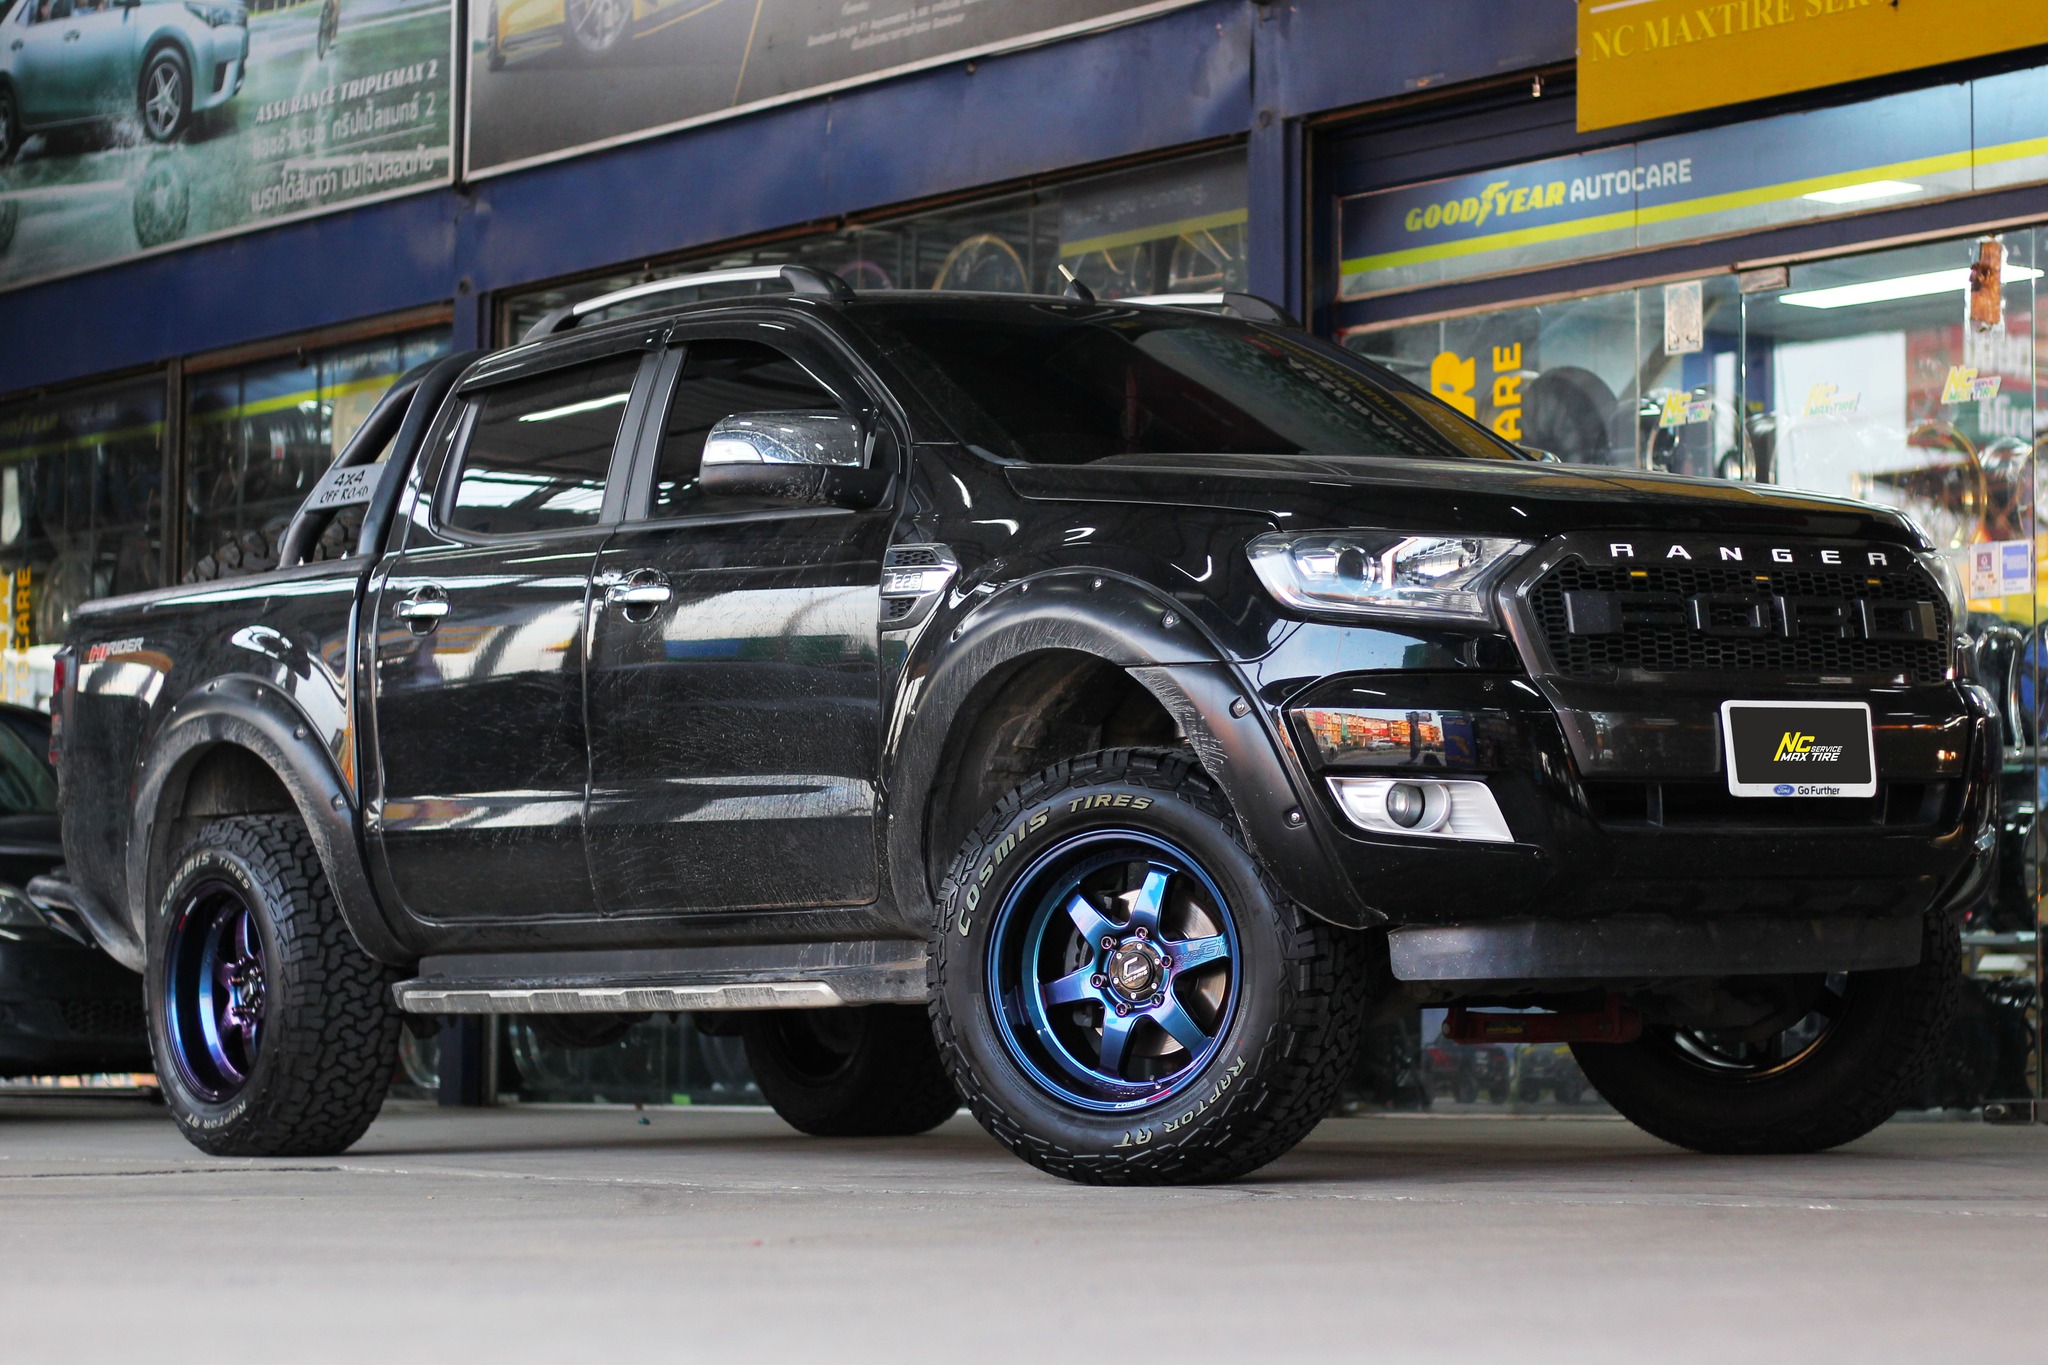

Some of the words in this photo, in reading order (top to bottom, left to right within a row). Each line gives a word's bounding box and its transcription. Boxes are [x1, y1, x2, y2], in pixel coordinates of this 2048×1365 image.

[1591, 24, 1635, 62] NC
[1644, 0, 1796, 52] MAXTIRE
[256, 84, 337, 124] ASSURANCE
[340, 64, 425, 101] TRIPLEMAX
[427, 58, 439, 79] 2
[425, 92, 437, 118] 2
[1405, 181, 1567, 232] GOODYEAR
[1570, 158, 1693, 203] AUTOCARE
[1493, 342, 1522, 441] ARE
[1609, 543, 1888, 566] RANGER
[1773, 731, 1815, 762] NC
[1780, 752, 1809, 762] MAX
[1811, 752, 1841, 762] TIRE
[1797, 786, 1810, 796] Go
[1811, 785, 1841, 796] Further
[160, 851, 212, 917] COSMIS
[219, 856, 251, 890] TIRES
[957, 806, 1051, 938] COSMIS
[1069, 794, 1154, 813] TIRES
[1162, 1055, 1249, 1134] RAPTOR
[1112, 1127, 1153, 1148] AT
